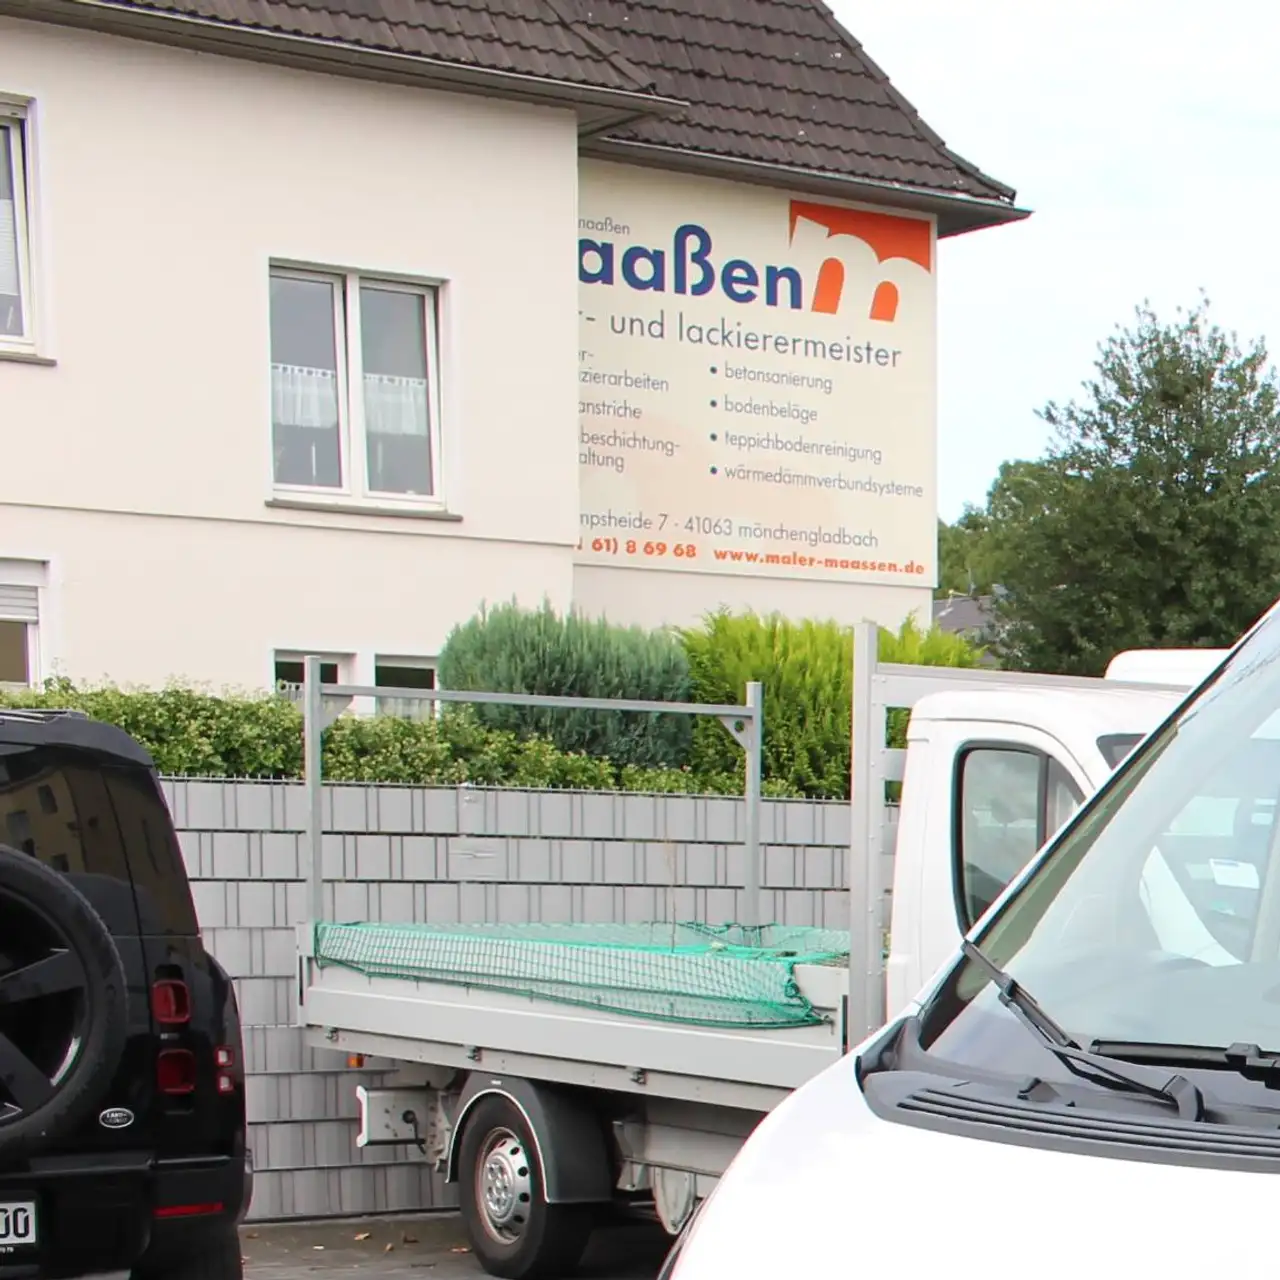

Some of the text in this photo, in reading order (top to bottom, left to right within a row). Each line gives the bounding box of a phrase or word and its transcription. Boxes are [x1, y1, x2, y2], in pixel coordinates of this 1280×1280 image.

[578, 224, 802, 310] aaßen
[610, 309, 664, 340] und
[679, 311, 902, 368] lackierermeister
[724, 361, 833, 394] betonsanierung
[578, 400, 643, 419] anstriche
[724, 395, 818, 425] bodenbeläge
[579, 425, 680, 457] beschichtung-
[724, 431, 882, 465] teppichbodenreinigung
[578, 446, 625, 473] altung
[724, 464, 924, 498] wärmedämmverbundsysteme
[658, 513, 668, 531] 7
[683, 516, 734, 535] 41063
[738, 523, 879, 547] mönchengladbach
[591, 538, 618, 555] 61)
[626, 540, 637, 554] 8
[643, 541, 667, 556] 69
[673, 543, 696, 559] 68
[713, 549, 925, 575] www.maler-maassen.de
